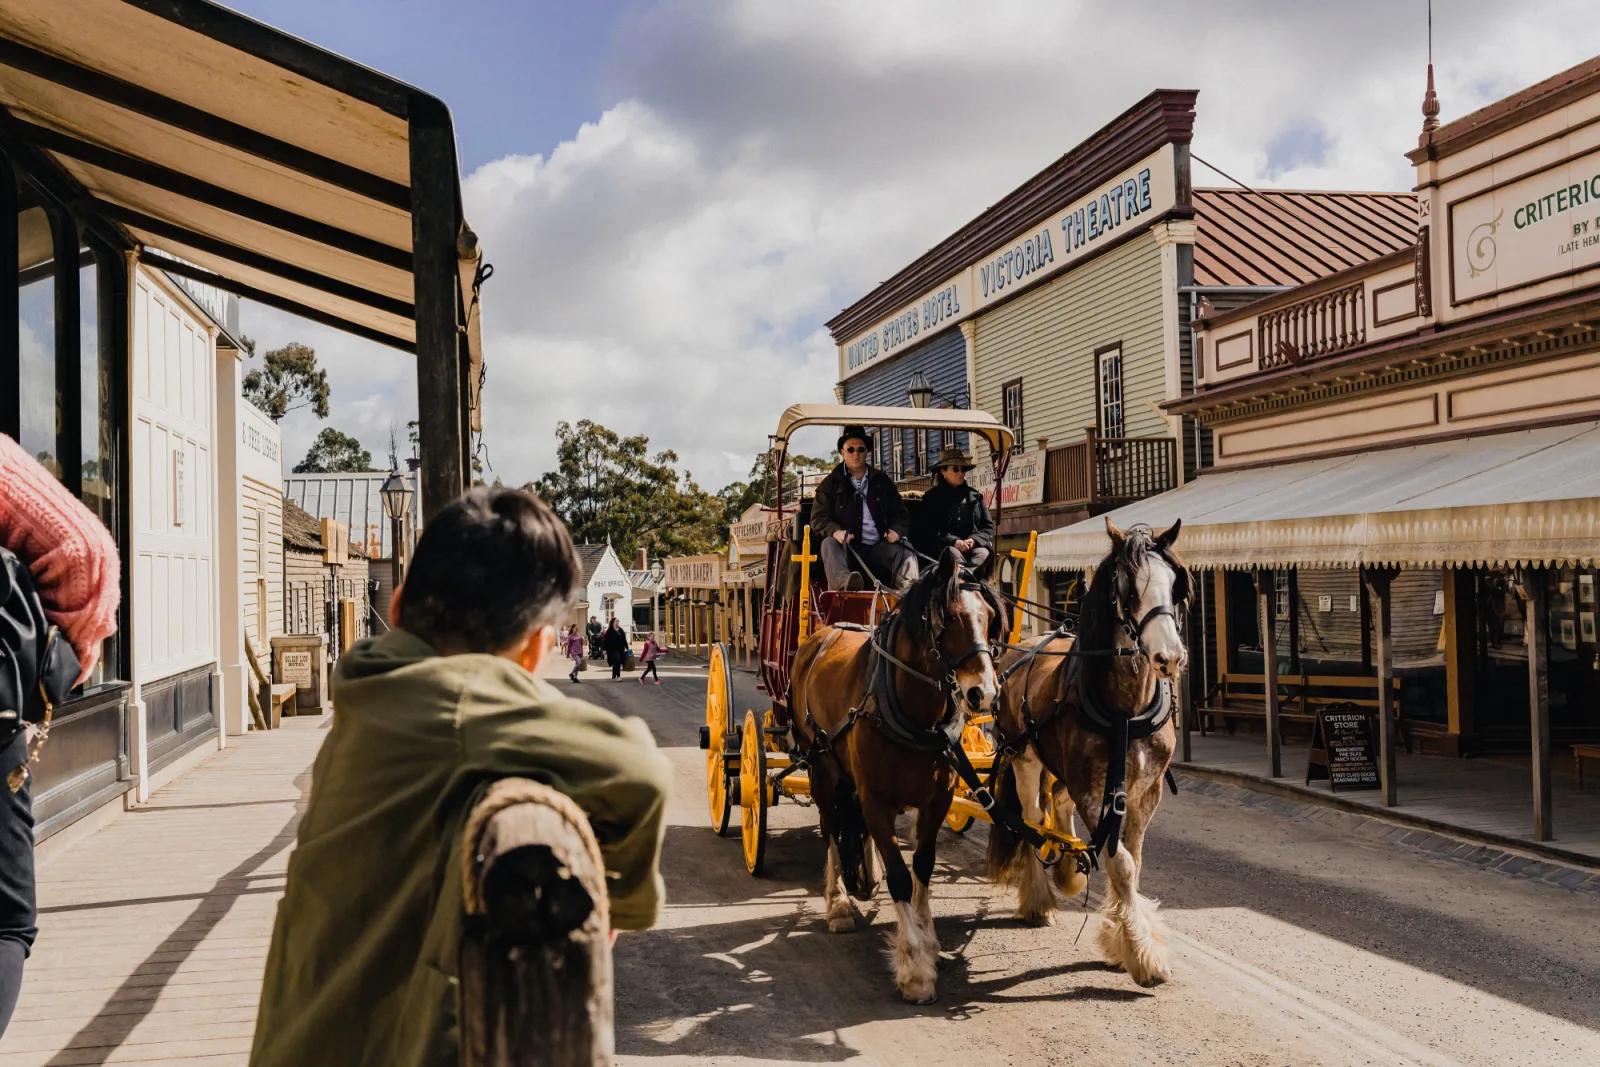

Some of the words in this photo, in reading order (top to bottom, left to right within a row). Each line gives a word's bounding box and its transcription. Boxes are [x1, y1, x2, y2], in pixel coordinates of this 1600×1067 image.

[980, 229, 1054, 297] VICTORIA
[1062, 168, 1152, 254] THEATRE
[1574, 220, 1589, 236] BY
[848, 332, 879, 370] UNITED
[882, 307, 919, 352] STATES
[922, 284, 960, 330] HOTEL
[1007, 464, 1037, 482] THEATRE
